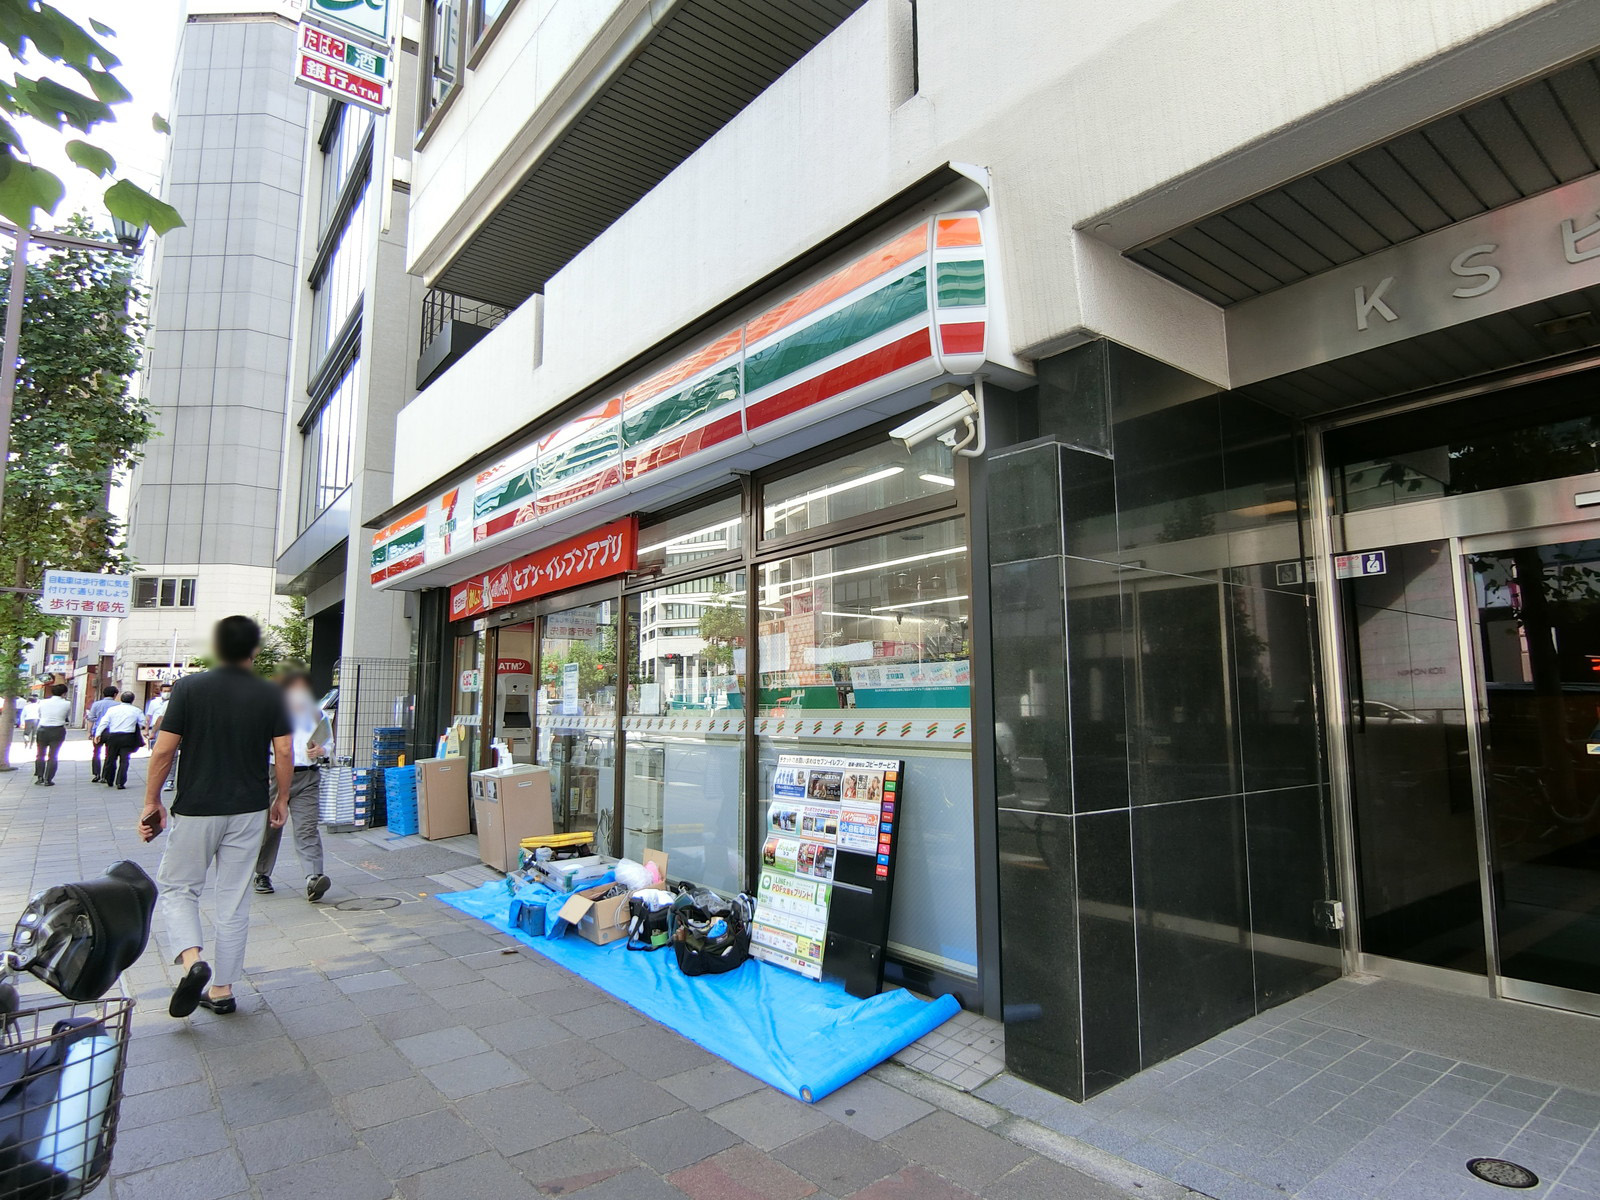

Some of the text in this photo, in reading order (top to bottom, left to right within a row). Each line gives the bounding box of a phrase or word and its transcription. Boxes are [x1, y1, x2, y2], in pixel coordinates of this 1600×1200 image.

[305, 29, 344, 61] たばこ
[354, 47, 378, 74] 酒
[305, 60, 379, 102] 銀行ATM
[48, 575, 130, 588] 自転車は歩行者に気を
[48, 585, 129, 598] 付けて通りましょう
[50, 598, 125, 613] 歩行者優先
[498, 662, 519, 671] ATM
